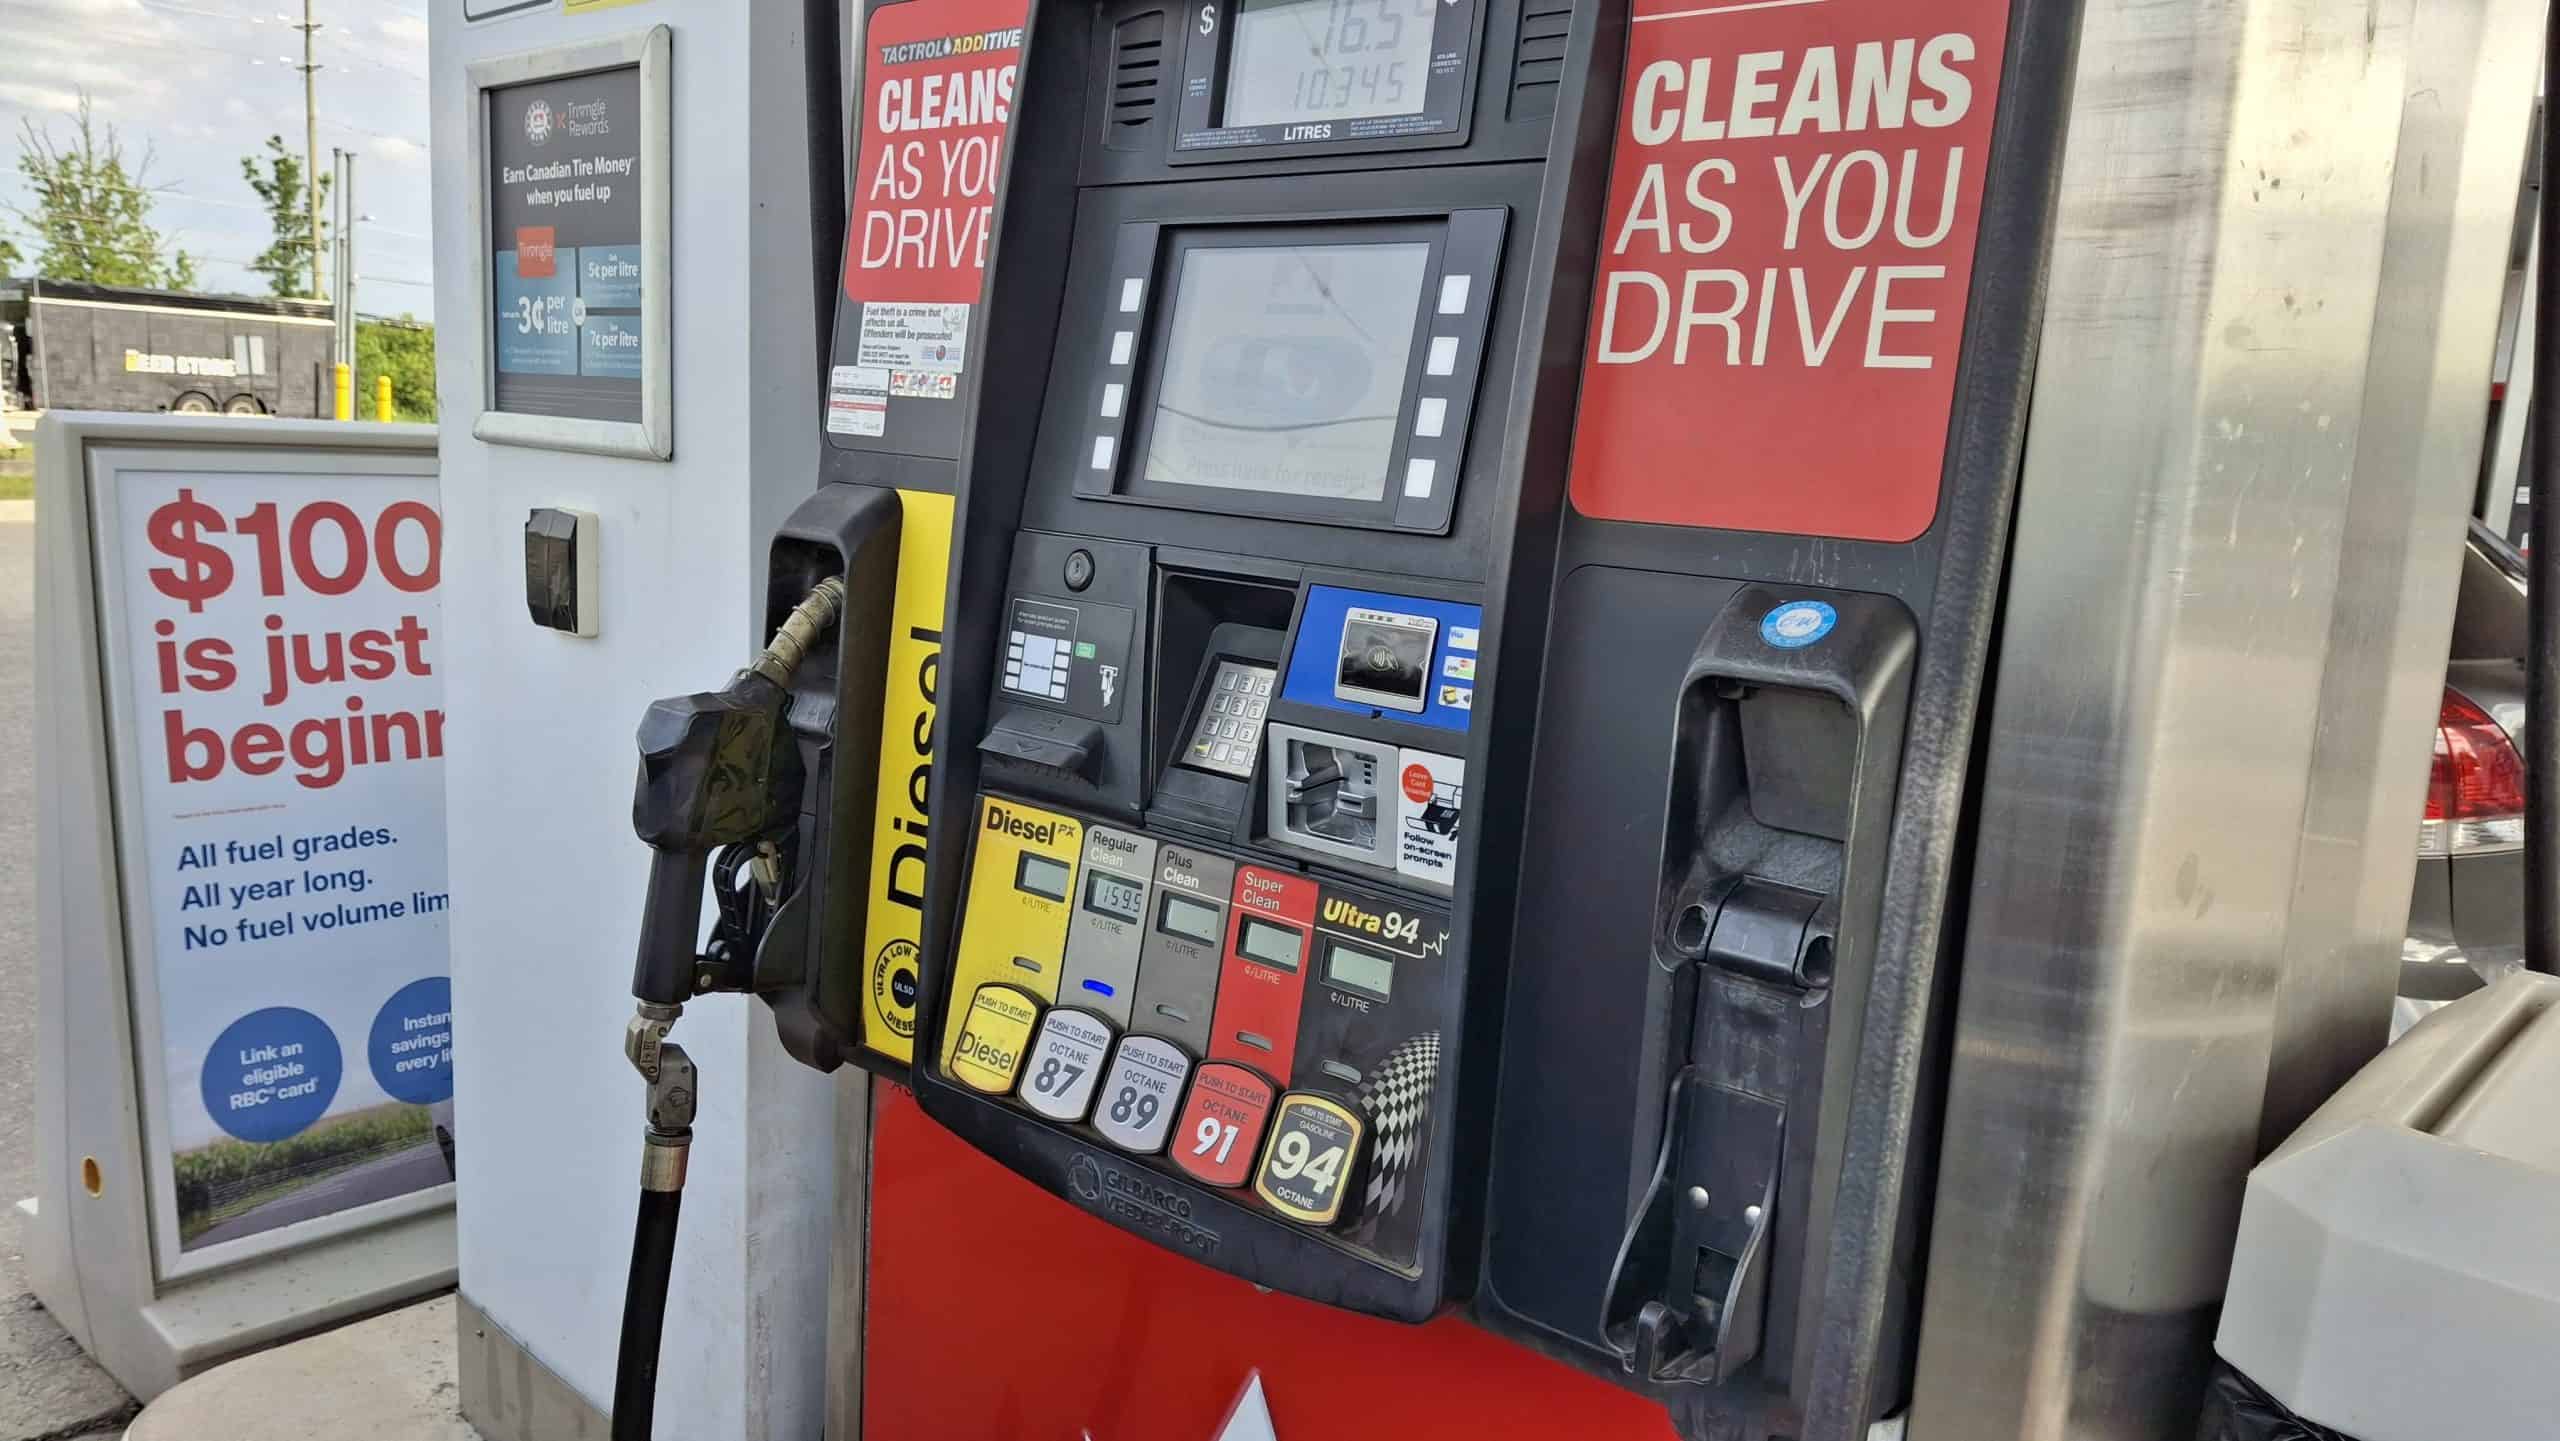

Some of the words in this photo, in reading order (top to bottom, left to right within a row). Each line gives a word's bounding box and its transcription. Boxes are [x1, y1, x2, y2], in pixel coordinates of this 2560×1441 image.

[1199, 5, 1215, 36] $
[1323, 0, 1431, 54] 16.5
[881, 43, 943, 64] TACTROL
[951, 29, 1024, 55] ADDITIVE
[878, 65, 1017, 133] CLEANS
[1631, 33, 1975, 146] CLEANS
[1284, 124, 1332, 141] LITRES
[503, 167, 525, 184] Earn
[526, 161, 571, 181] Canadian
[572, 159, 593, 176] Tire
[870, 141, 925, 200] AS
[527, 189, 552, 205] when
[554, 190, 573, 207] you
[574, 183, 595, 201] fuel
[597, 185, 610, 204] up
[1613, 158, 1736, 255] AS
[1774, 146, 1964, 250] YOU
[601, 264, 618, 281] per
[619, 261, 639, 277] litre
[518, 296, 544, 334] 3¢
[547, 296, 565, 311] per
[547, 316, 568, 334] litre
[1597, 265, 1946, 369] DRIVE
[601, 333, 618, 350] per
[619, 330, 639, 347] litre
[147, 488, 442, 614] $100
[155, 619, 238, 694] is
[263, 614, 432, 706] just
[986, 806, 1056, 846] Diesel
[178, 844, 217, 872] All
[226, 835, 283, 865] fuel
[293, 826, 398, 862] grades.
[1093, 831, 1139, 854] Regular
[1404, 832, 1435, 846] Follow
[1404, 842, 1452, 860] on-screen
[1090, 846, 1124, 867] Clean
[1166, 850, 1193, 869] Plus
[1403, 853, 1444, 868] prompts
[181, 883, 220, 911] All
[230, 878, 295, 910] year
[304, 868, 373, 892] long.
[1163, 867, 1200, 889] Clean
[1244, 871, 1284, 893] Super
[1103, 886, 1141, 913] 159.5
[1242, 889, 1280, 911] Clean
[184, 924, 228, 950] No
[236, 912, 294, 942] fuel
[302, 898, 405, 932] volume
[890, 946, 911, 958] LOW
[877, 956, 891, 996] ULTRA
[977, 993, 997, 1009] PUSH
[998, 1000, 1008, 1012] TO
[1009, 1005, 1033, 1021] START
[404, 1012, 451, 1031] Instan
[1048, 1018, 1069, 1033] PUSH
[1070, 1025, 1081, 1037] TO
[1081, 1030, 1107, 1046] START
[240, 1045, 277, 1065] Link
[281, 1043, 304, 1057] an
[391, 1031, 450, 1054] savings
[959, 1031, 1019, 1072] Diesel
[1049, 1041, 1089, 1065] OCTANE
[396, 1054, 439, 1073] every
[1123, 1044, 1145, 1060] PUSH
[1146, 1052, 1157, 1064] TO
[1158, 1056, 1184, 1074] START
[243, 1062, 304, 1087] eligible
[1035, 1057, 1085, 1099] 87
[1124, 1070, 1167, 1094] OCTANE
[1199, 1073, 1224, 1090] PUSH
[1226, 1081, 1237, 1093] TO
[1238, 1087, 1266, 1104] START
[1110, 1086, 1159, 1130] 89
[1202, 1099, 1248, 1123] OCTANE
[1192, 1117, 1239, 1165] 91
[1300, 1120, 1336, 1140] GASOLINE
[1272, 1131, 1345, 1195] 94
[1105, 1168, 1192, 1218] GILBARCO
[1277, 1187, 1314, 1209] OCTANE
